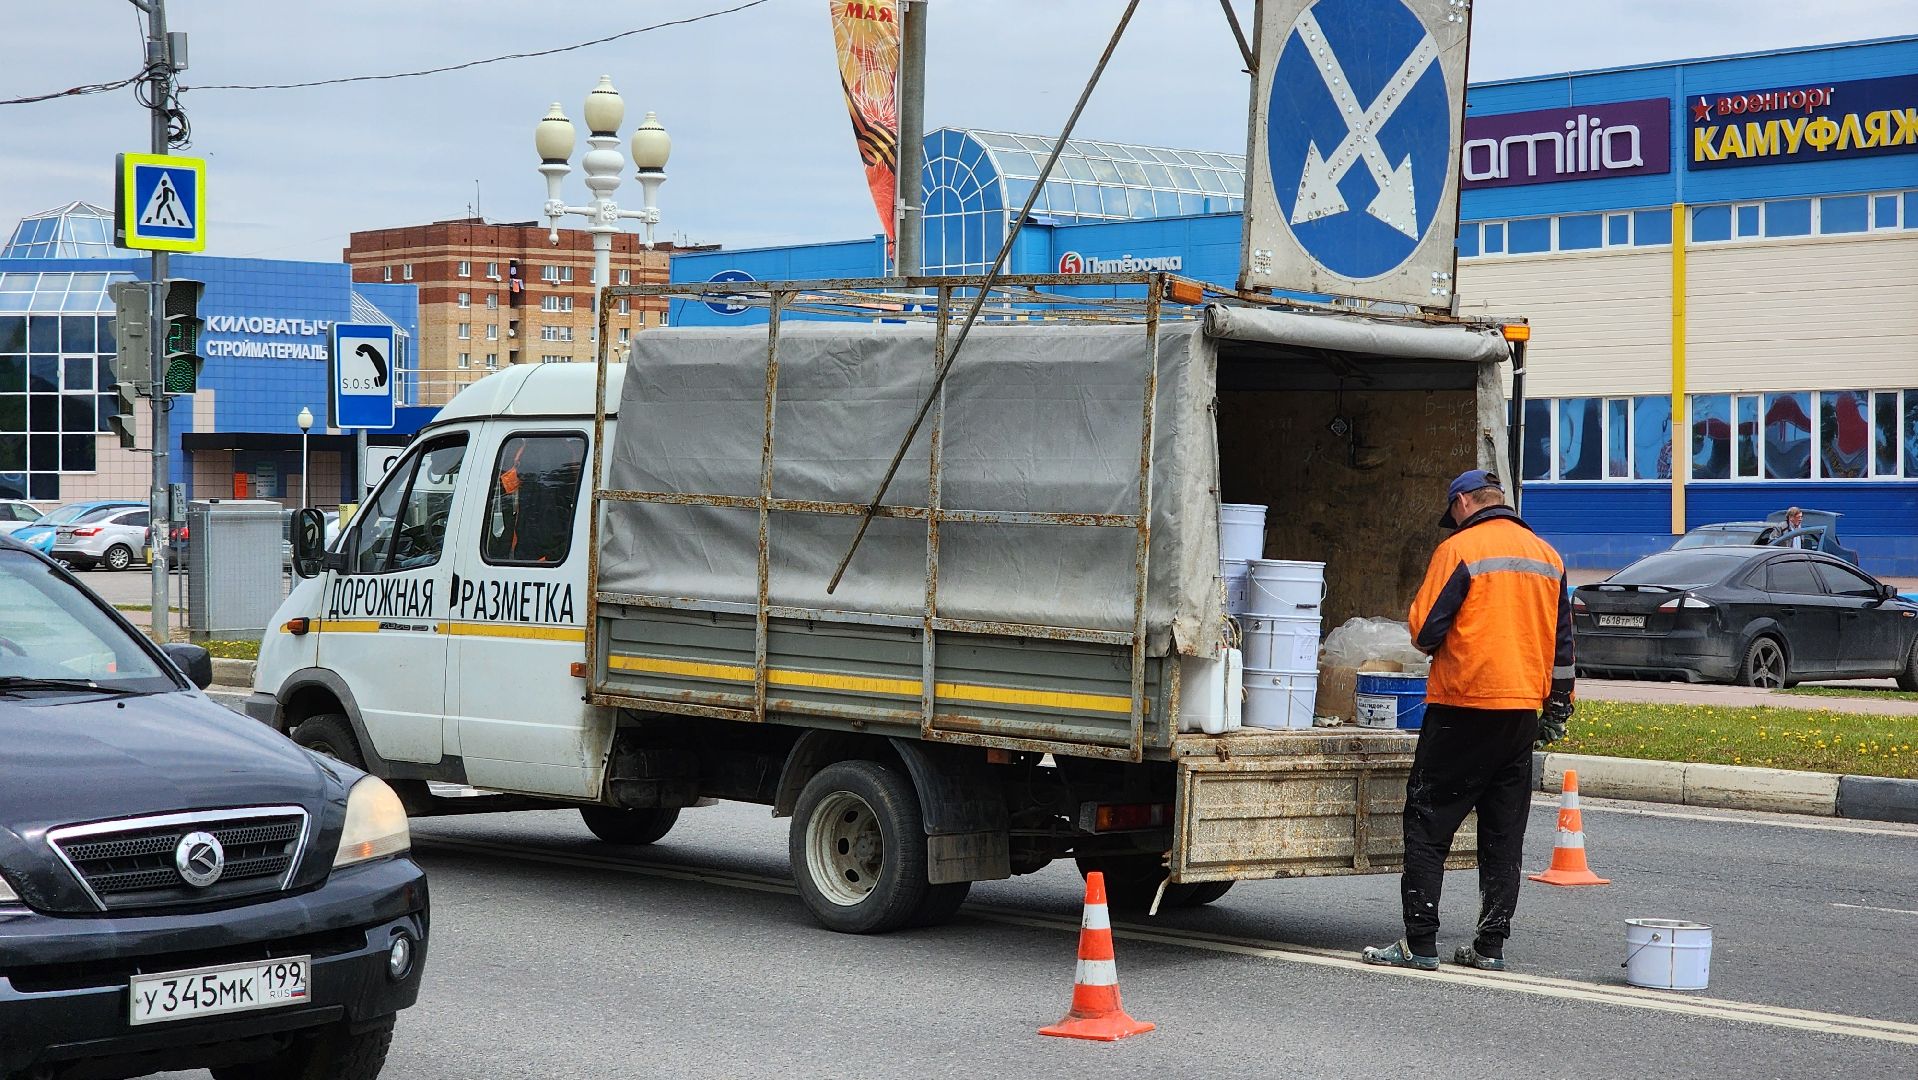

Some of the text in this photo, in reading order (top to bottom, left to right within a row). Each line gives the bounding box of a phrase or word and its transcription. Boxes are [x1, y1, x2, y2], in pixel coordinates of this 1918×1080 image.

[844, 2, 893, 23] МАЯ
[1694, 107, 1918, 162] КАМУФЛЯЖ
[1086, 254, 1182, 273] Пятёрочка
[342, 378, 374, 389] S.O.S.
[328, 578, 574, 623] ДОРОЖНАЯ РАЗМЕТКА
[144, 962, 301, 1015] У345МК 199
[269, 990, 290, 999] RUS
